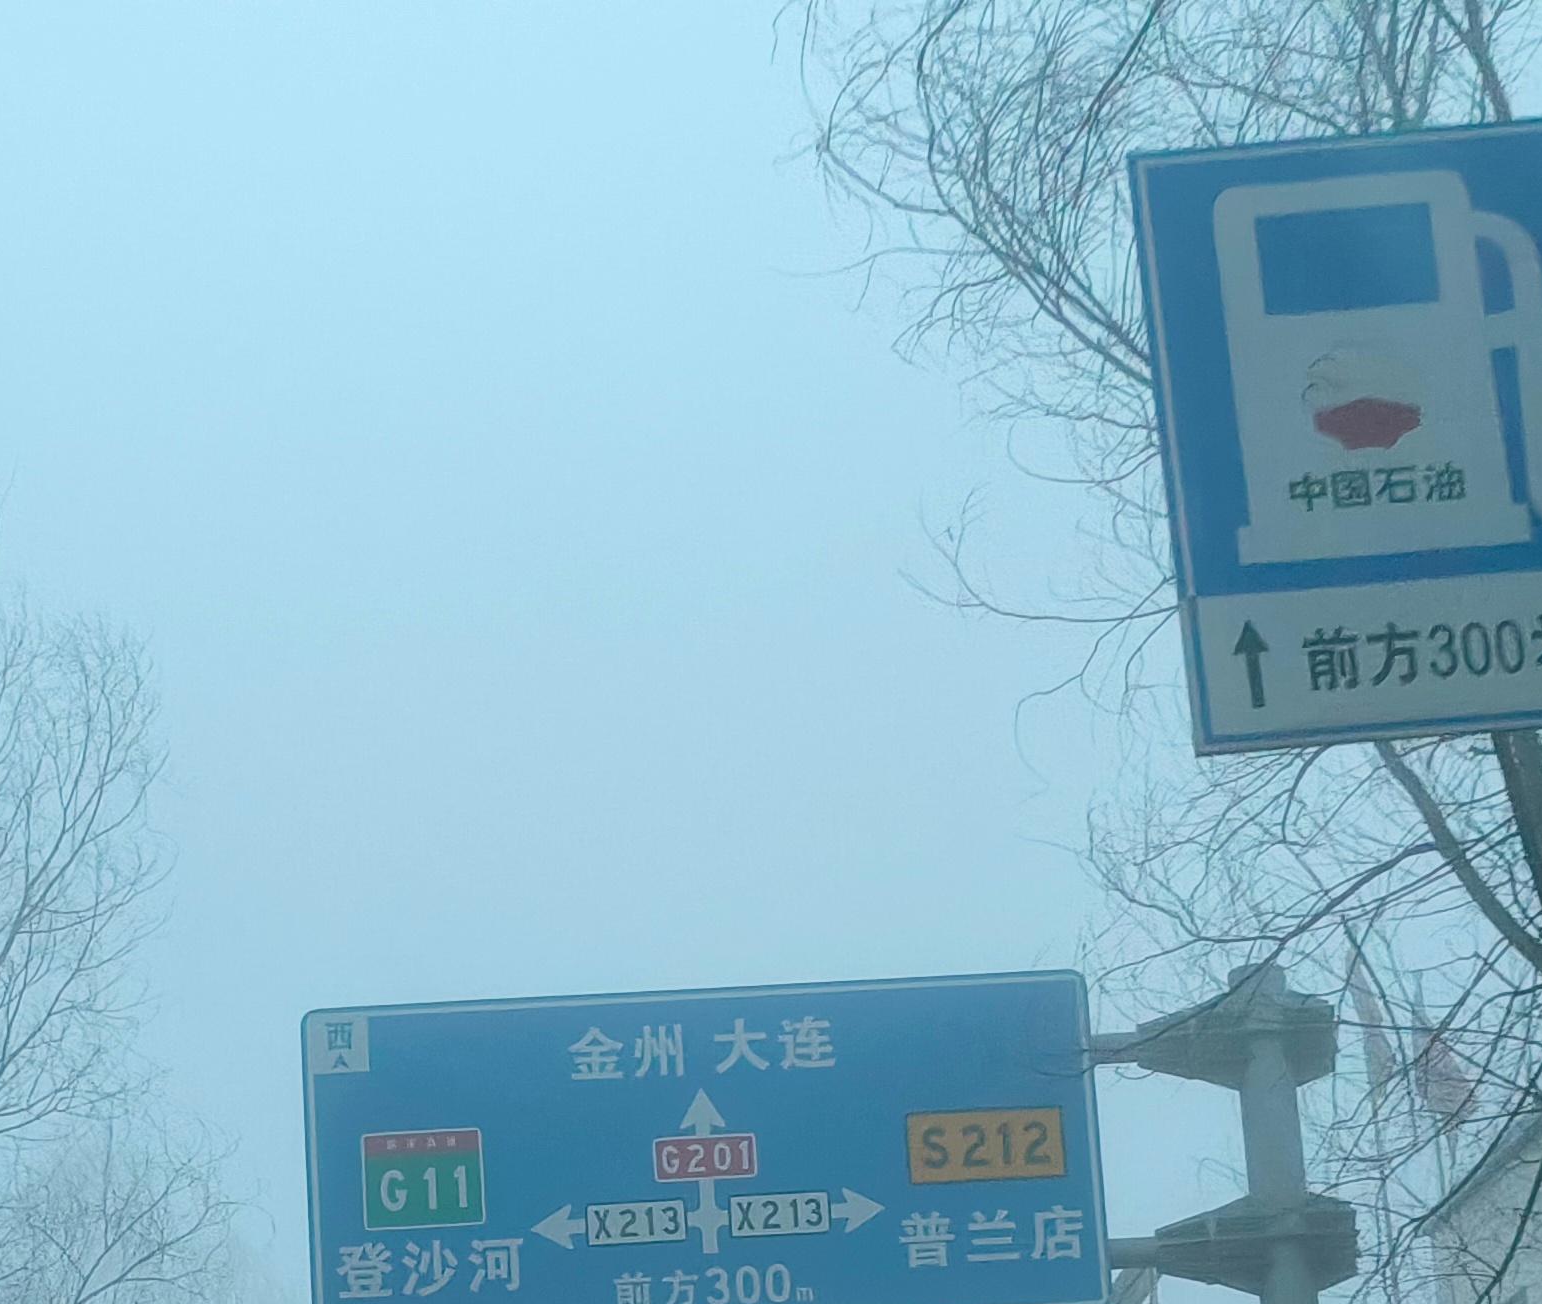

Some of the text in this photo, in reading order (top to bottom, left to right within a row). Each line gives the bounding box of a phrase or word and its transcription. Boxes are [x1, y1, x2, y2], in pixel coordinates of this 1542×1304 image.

[1288, 462, 1465, 512] 中国石油
[327, 1022, 353, 1051] 西
[661, 1140, 751, 1174] G201
[922, 1120, 1051, 1169] S212
[380, 1165, 468, 1212] G11
[593, 1208, 682, 1240] X213
[736, 1198, 824, 1231] X213
[898, 1206, 1084, 1268] 普兰店
[337, 1238, 524, 1299] 登沙河
